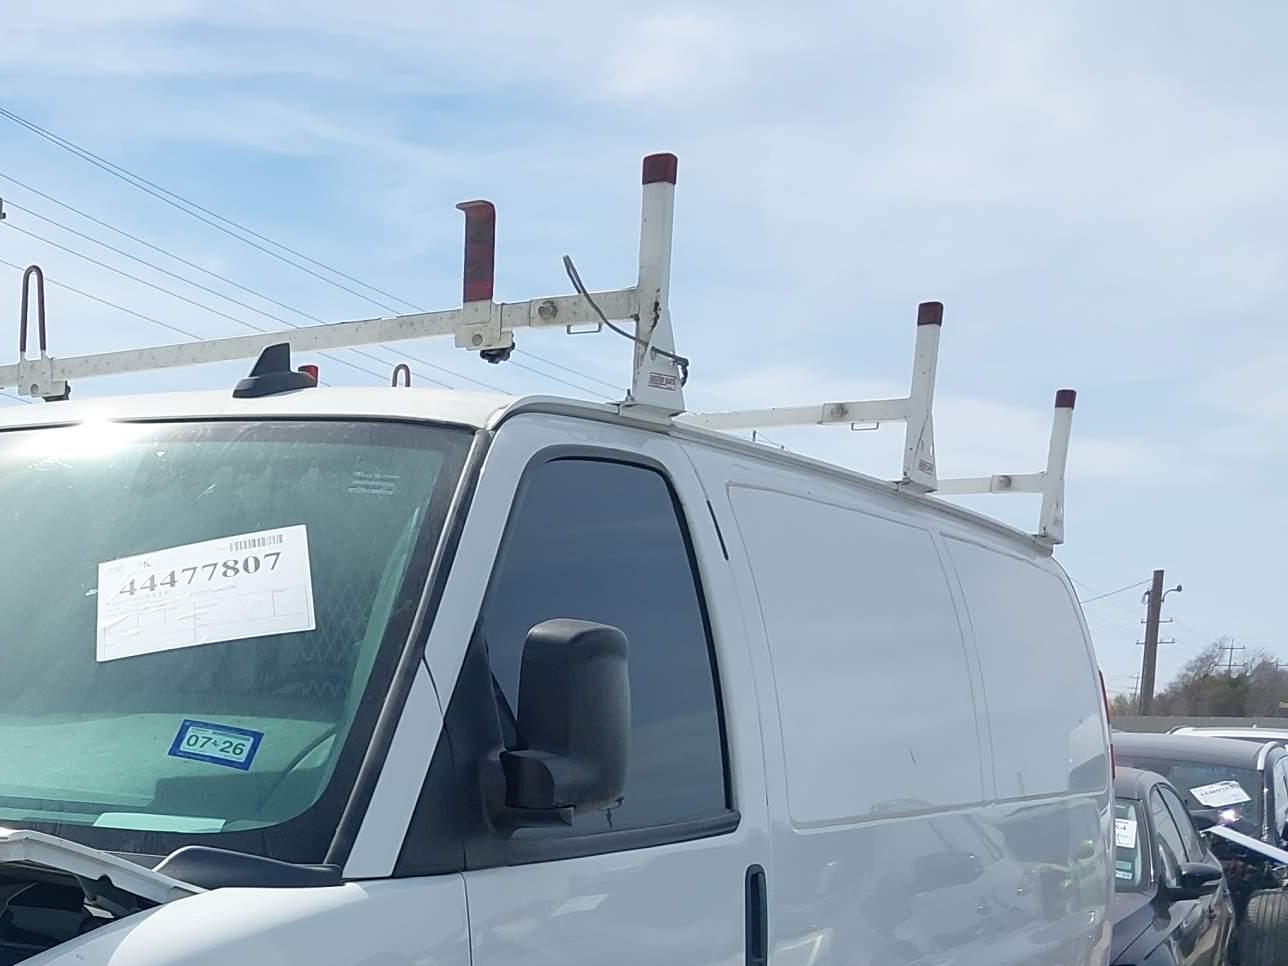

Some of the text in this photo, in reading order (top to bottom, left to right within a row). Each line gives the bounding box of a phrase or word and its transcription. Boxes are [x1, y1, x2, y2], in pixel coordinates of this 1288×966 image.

[119, 552, 282, 597] 44477807
[186, 734, 213, 749] 07
[219, 740, 246, 756] 26
